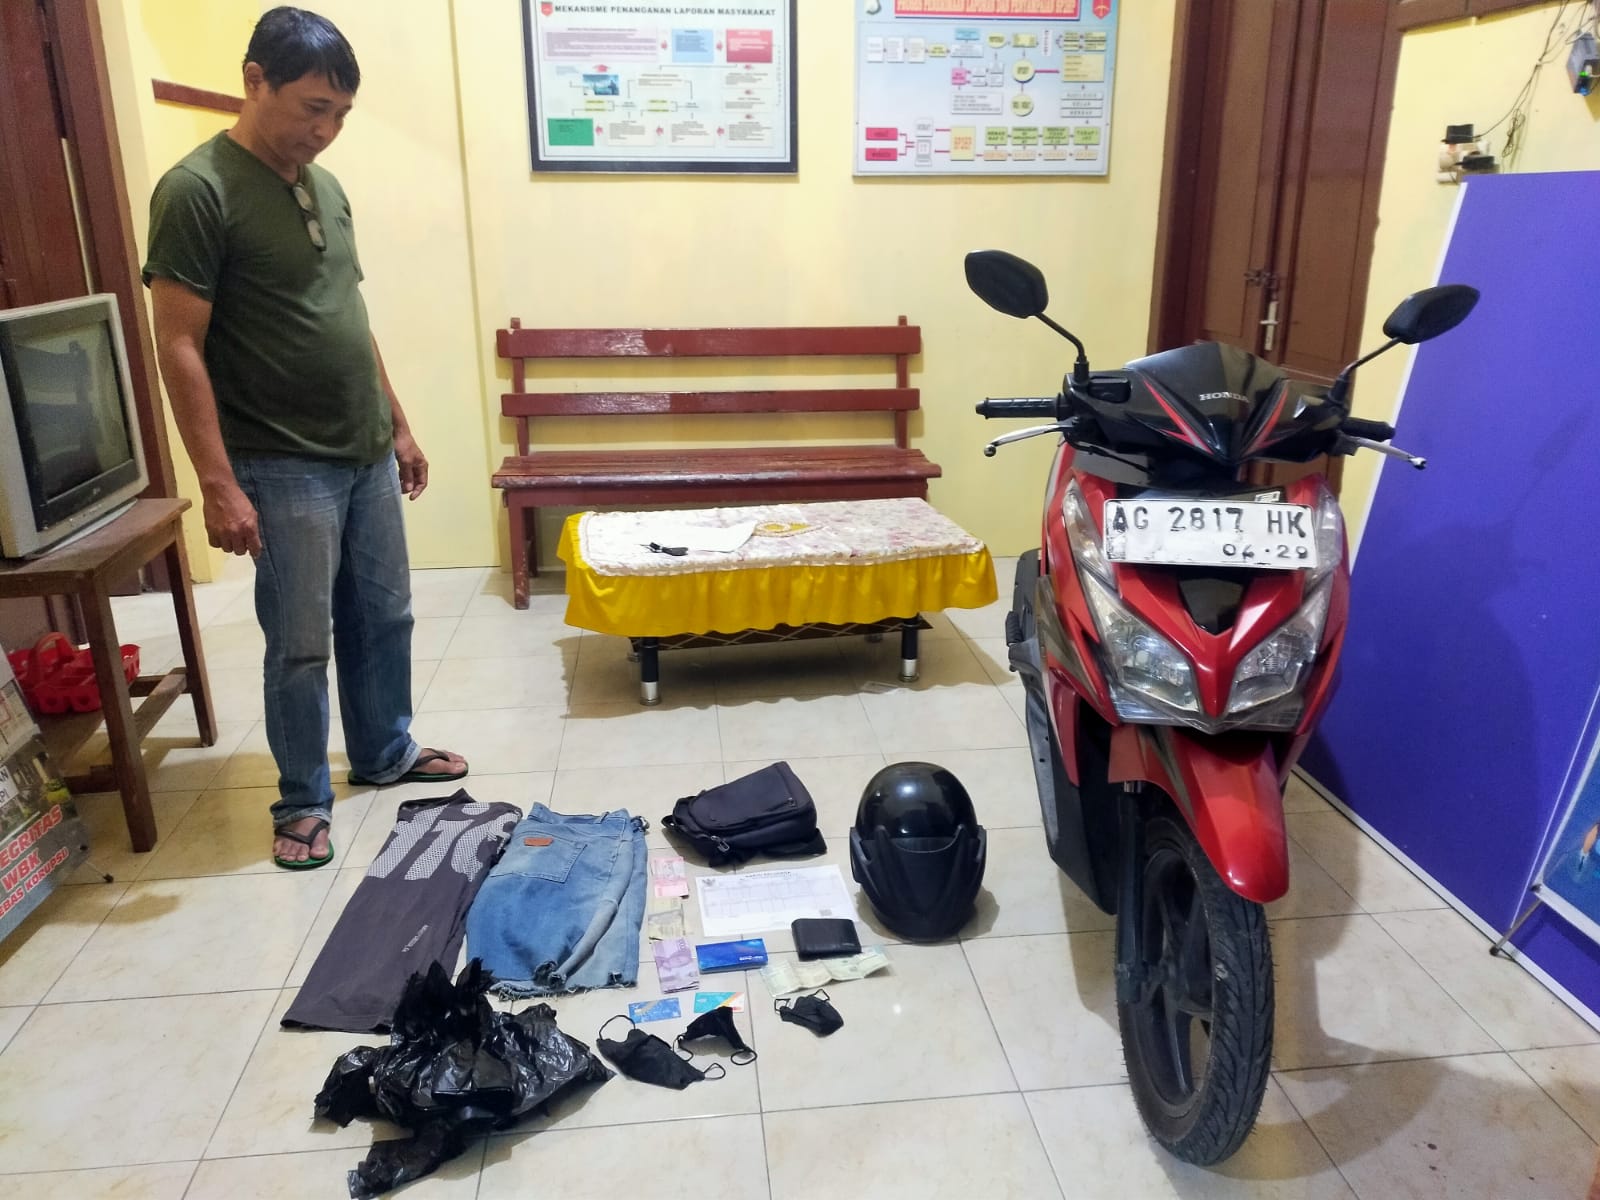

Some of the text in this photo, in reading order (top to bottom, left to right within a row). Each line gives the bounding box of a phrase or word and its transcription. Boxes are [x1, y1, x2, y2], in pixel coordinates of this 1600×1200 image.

[555, 5, 607, 13] MEKANISME
[611, 6, 671, 14] PENANGANAN
[718, 8, 776, 16] MASYARAKAT
[1199, 391, 1250, 403] HONDA
[1112, 505, 1306, 538] AG 2817 HK
[1, 848, 42, 892] WBK
